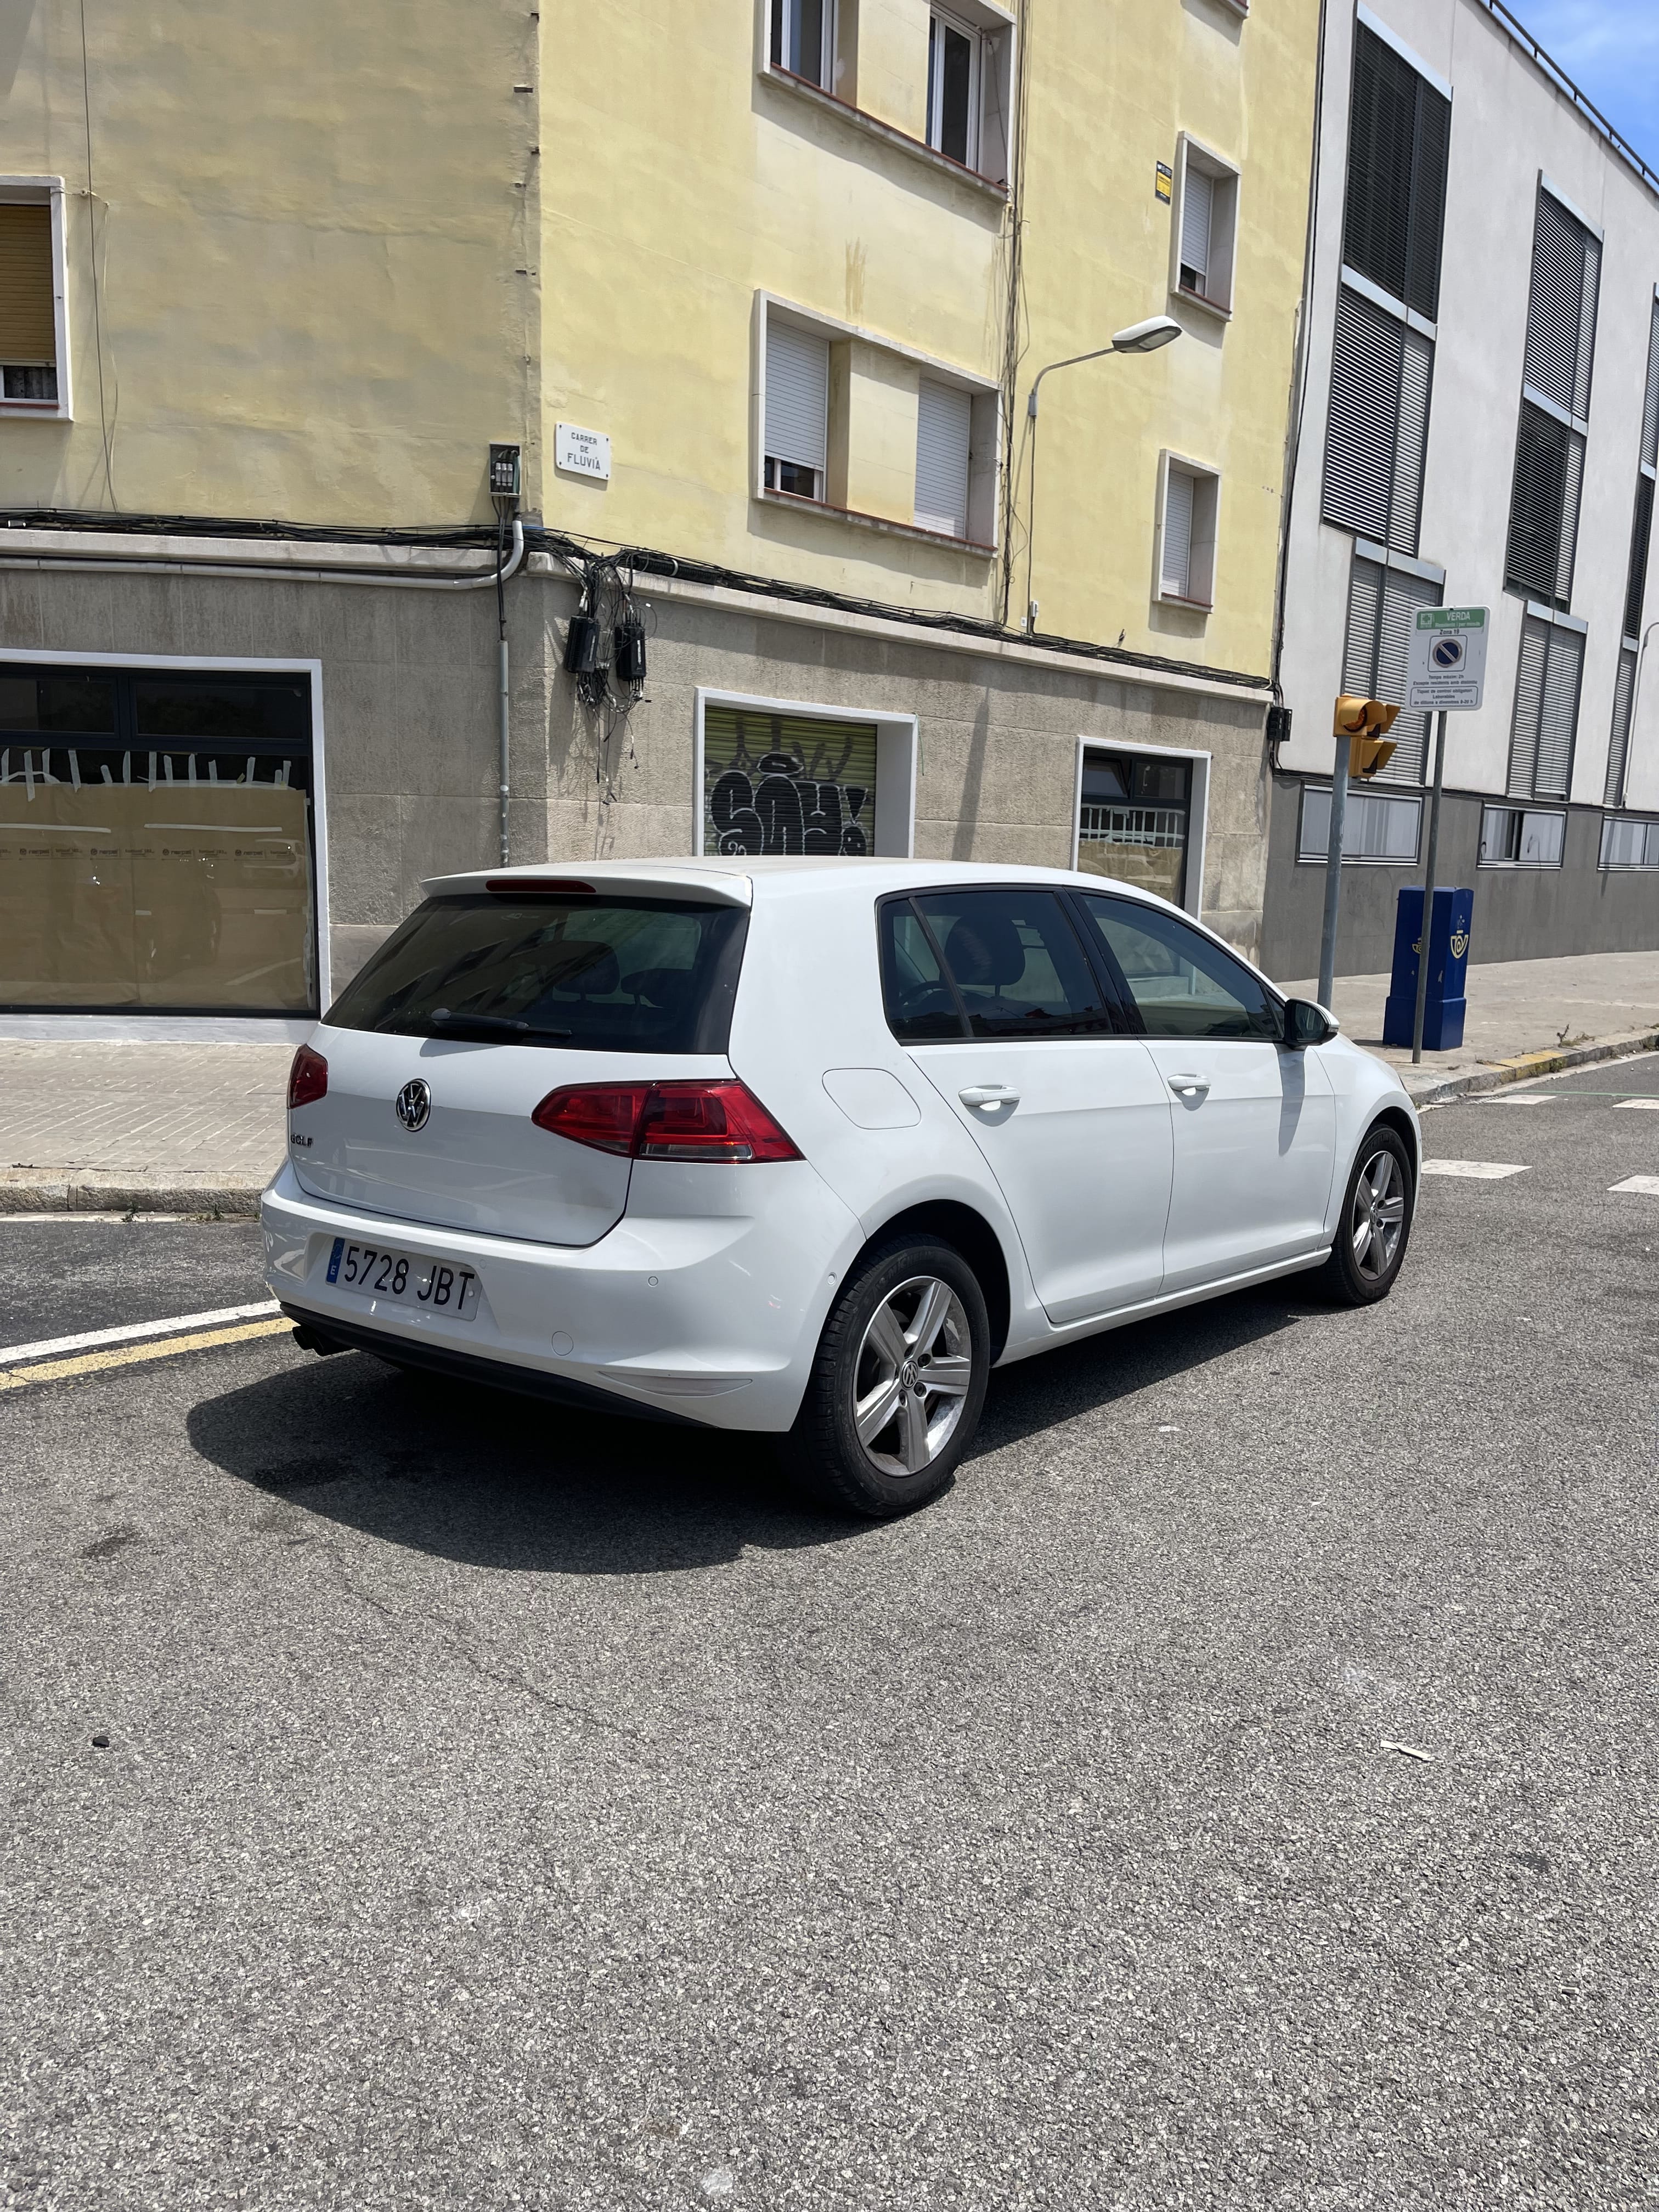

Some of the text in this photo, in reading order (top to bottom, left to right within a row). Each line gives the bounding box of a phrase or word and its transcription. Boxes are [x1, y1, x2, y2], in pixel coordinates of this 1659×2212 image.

[571, 432, 597, 445] CARRER
[580, 445, 589, 454] DE
[1446, 612, 1471, 621] VERDA
[290, 1132, 313, 1148] GOLF
[330, 1265, 337, 1276] E
[344, 1246, 475, 1310] 5728 JBT
